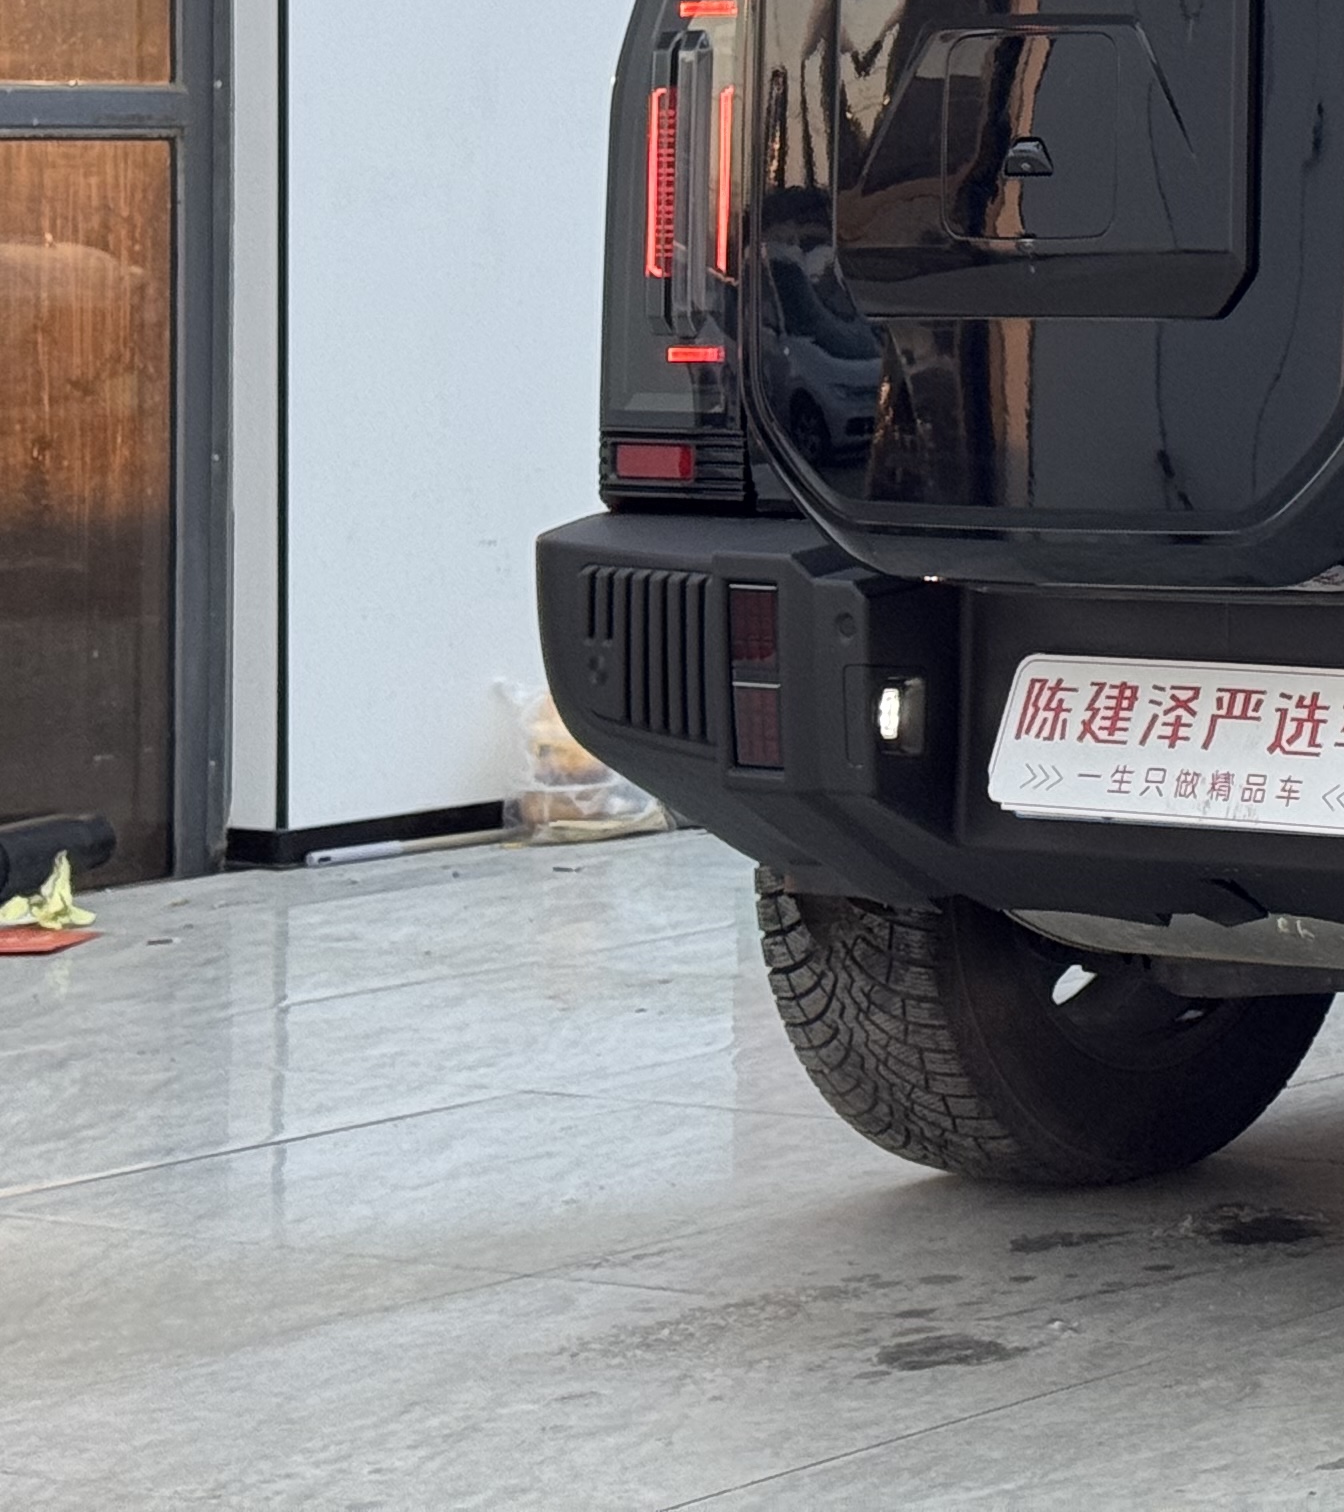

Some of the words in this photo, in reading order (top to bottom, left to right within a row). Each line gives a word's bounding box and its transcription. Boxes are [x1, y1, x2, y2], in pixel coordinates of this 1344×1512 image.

[1076, 763, 1304, 808] 一生只做精品车
